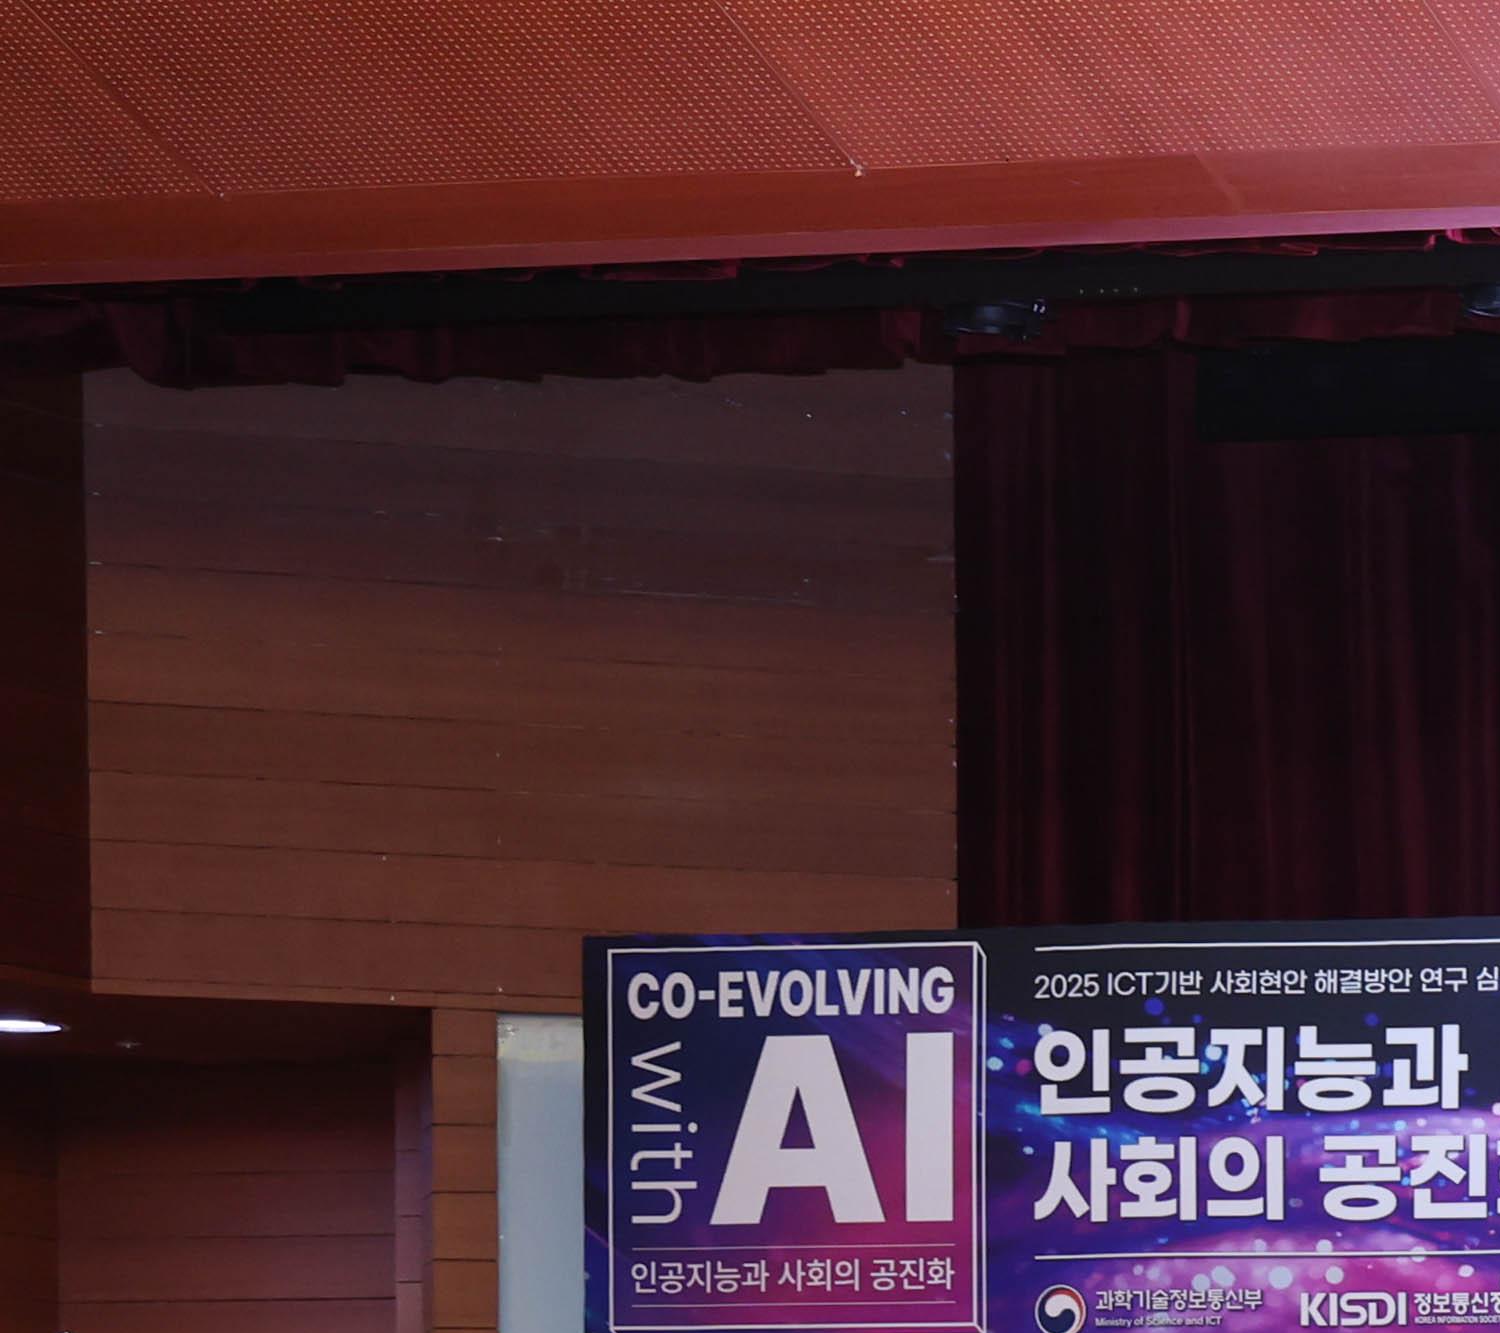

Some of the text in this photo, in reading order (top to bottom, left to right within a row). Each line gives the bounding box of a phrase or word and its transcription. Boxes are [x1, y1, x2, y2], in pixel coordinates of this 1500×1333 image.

[628, 965, 956, 1020] CO-EVOLVING
[1034, 971, 1099, 999] 2025
[1106, 968, 1203, 998] ICT기반
[1209, 966, 1309, 996] 사회현안
[1314, 965, 1412, 995] 해결방안
[1417, 964, 1468, 994] 연구
[1035, 1025, 1469, 1115] 인공지능과
[629, 1040, 698, 1226] with
[709, 1032, 955, 1225] AI
[1033, 1137, 1288, 1224] 사회의
[630, 1257, 955, 1294] 인공지능과 사회의 공진화
[1095, 1288, 1263, 1311] 과학기술정보통신부
[1300, 1291, 1406, 1326] KISDI
